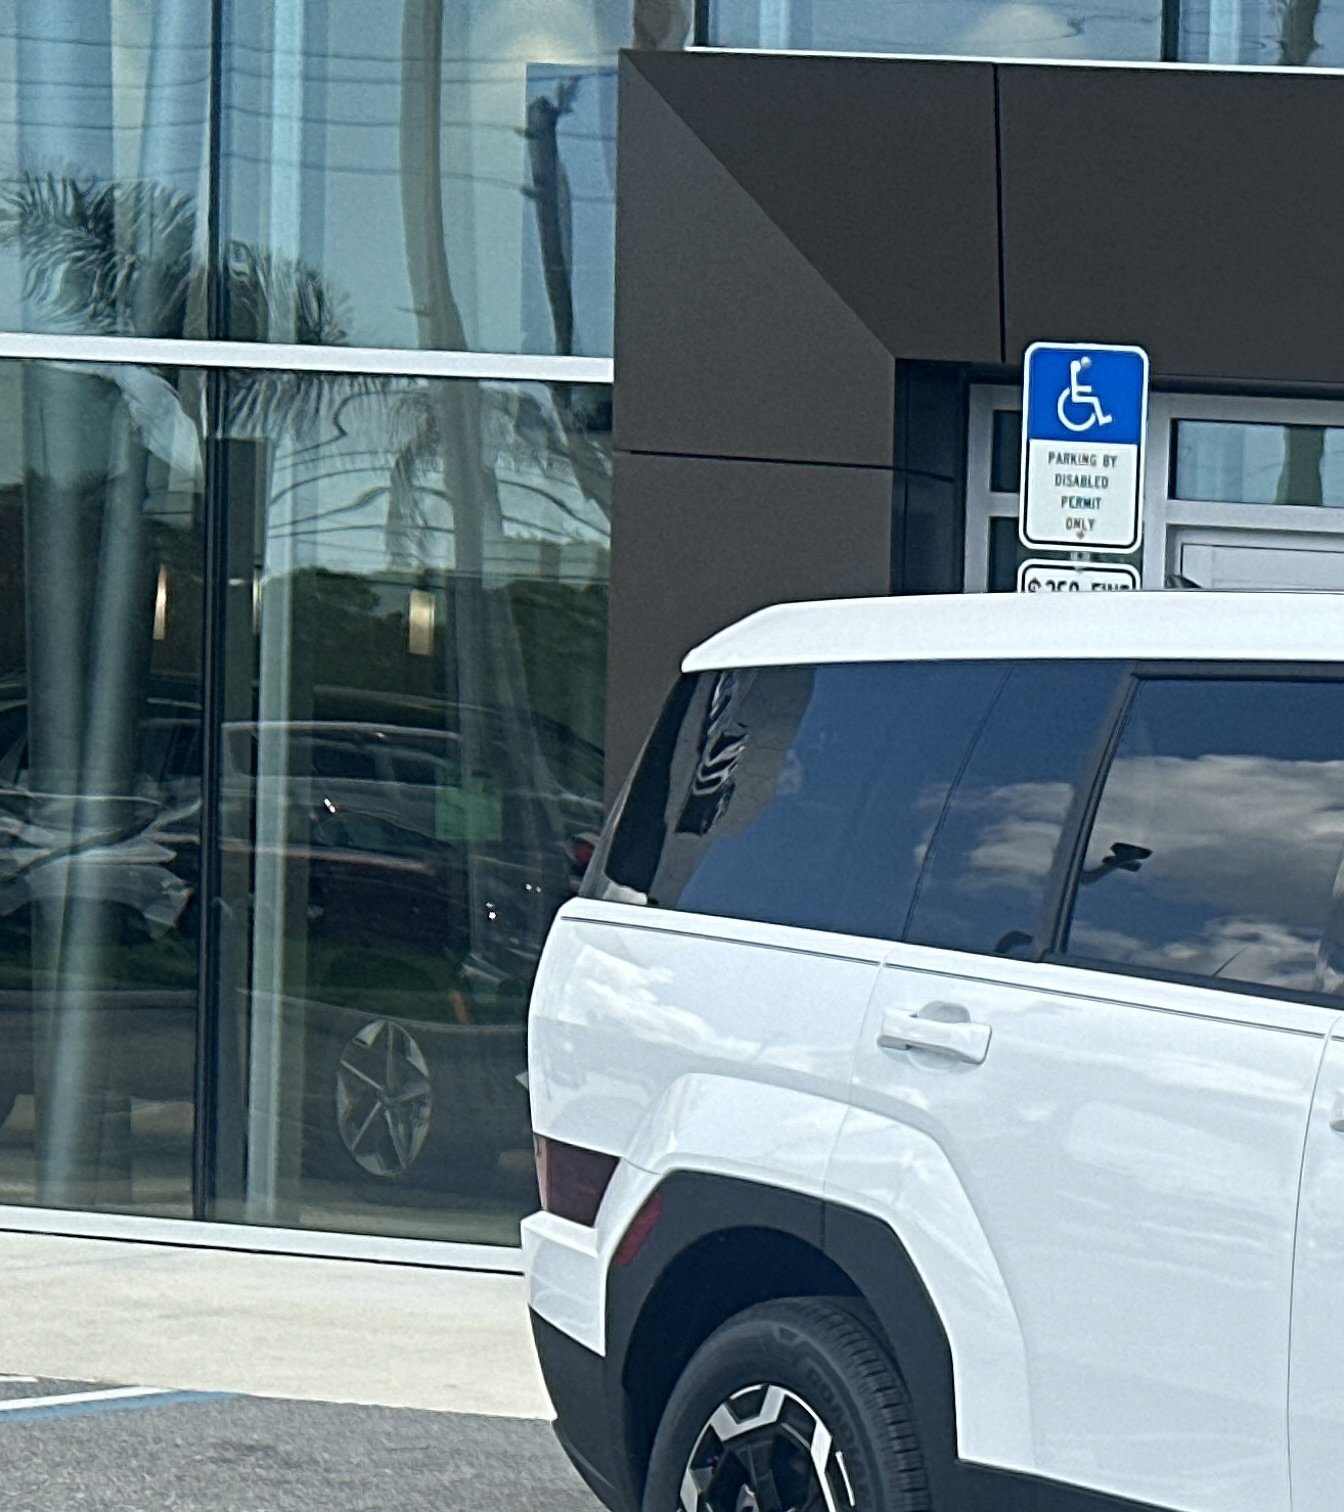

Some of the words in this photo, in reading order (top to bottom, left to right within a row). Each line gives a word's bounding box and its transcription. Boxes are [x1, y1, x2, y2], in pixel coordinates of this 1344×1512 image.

[1048, 451, 1097, 467] PARKING
[1103, 454, 1118, 468] BY
[1055, 473, 1109, 489] DISABLED
[1061, 495, 1102, 510] PERMIT
[1066, 516, 1096, 531] ONLY
